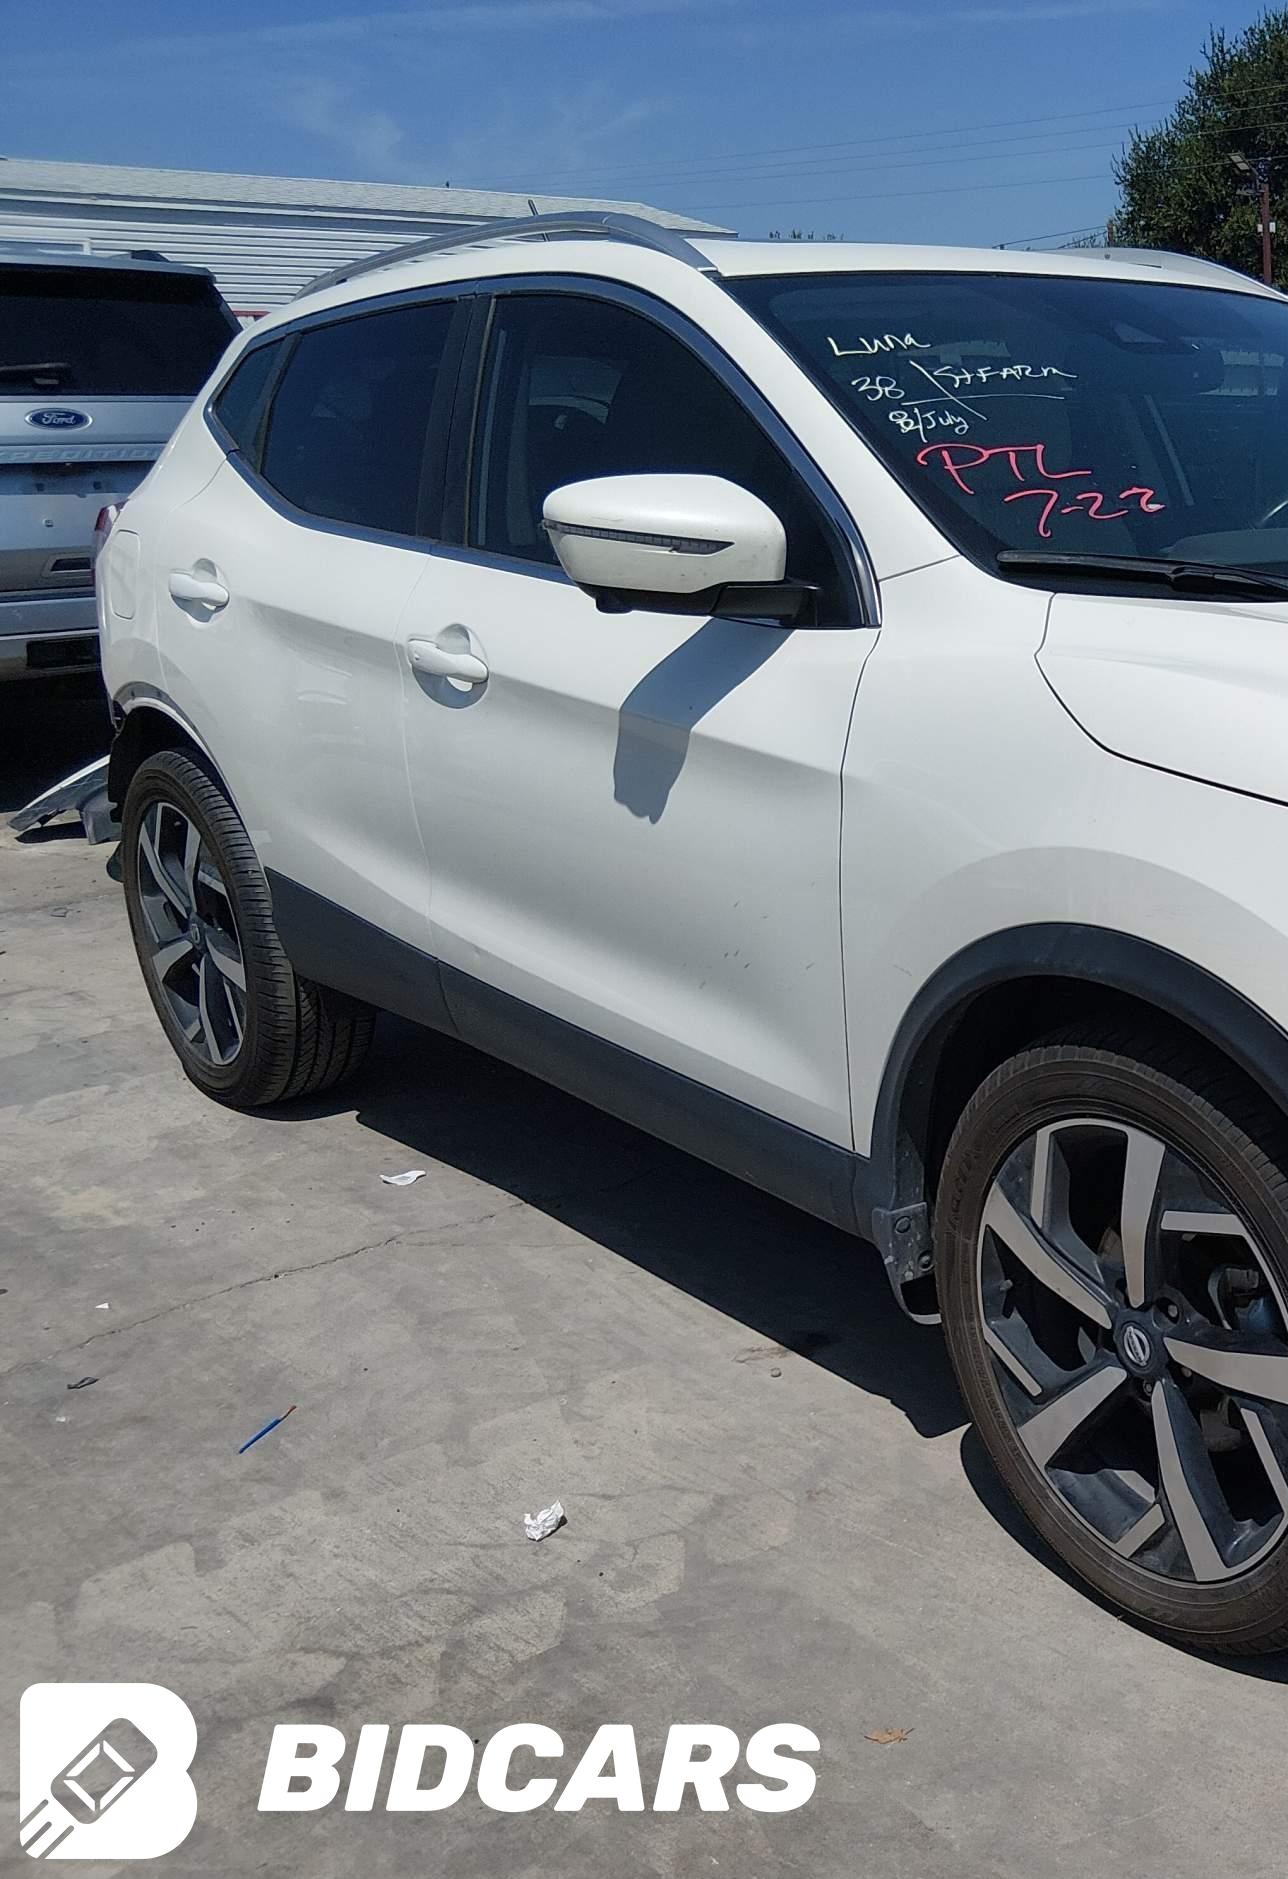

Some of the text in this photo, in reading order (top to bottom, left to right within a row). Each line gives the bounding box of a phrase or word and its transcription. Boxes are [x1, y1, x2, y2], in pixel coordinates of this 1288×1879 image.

[851, 376, 905, 401] 38
[42, 412, 77, 425] Ford
[0, 449, 158, 461] PEDITIO
